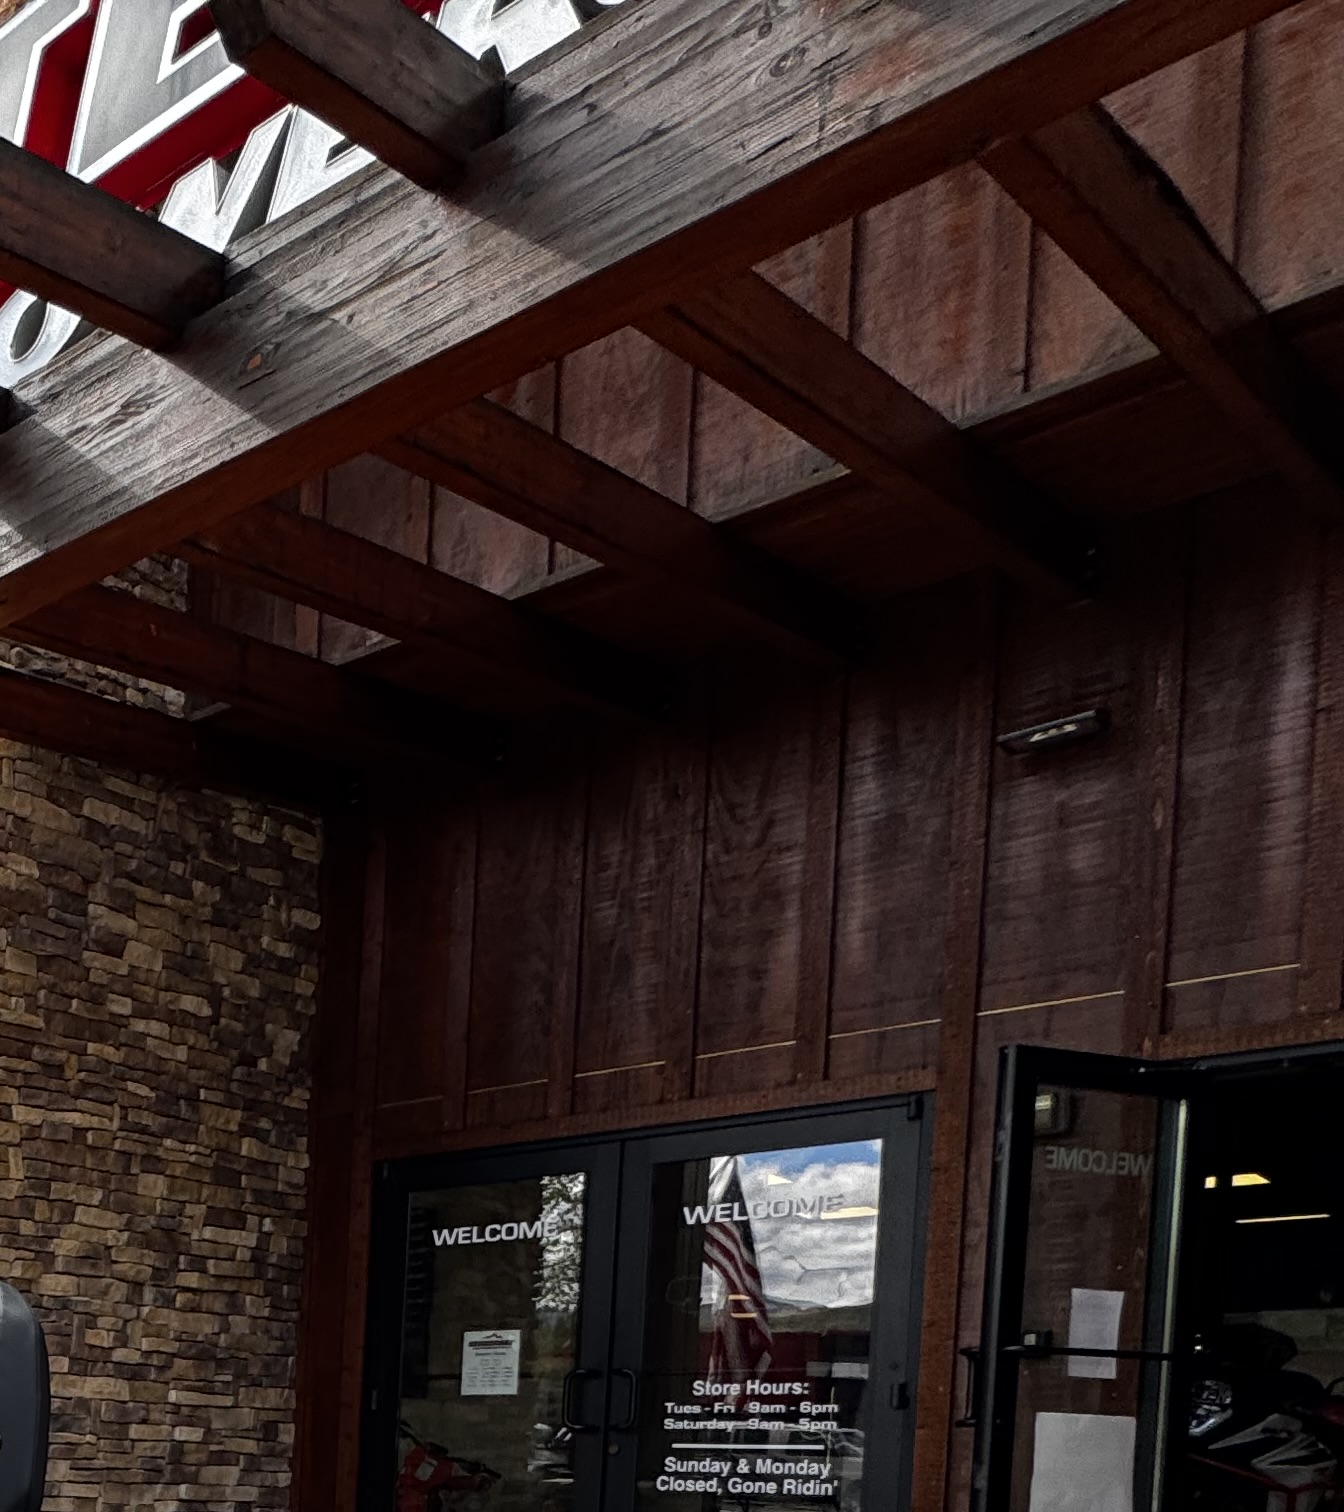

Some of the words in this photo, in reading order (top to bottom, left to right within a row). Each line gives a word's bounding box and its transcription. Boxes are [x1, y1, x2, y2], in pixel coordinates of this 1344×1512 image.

[683, 1193, 846, 1226] WELCOME
[432, 1212, 561, 1246] WELCOME
[692, 1379, 741, 1396] Store
[746, 1379, 810, 1396] Hours:
[664, 1402, 701, 1414] Tues
[713, 1402, 735, 1414] Fri
[748, 1401, 785, 1414] 9am
[799, 1401, 839, 1416] 6pm
[663, 1418, 735, 1432] Saturday
[747, 1418, 784, 1430] 9am
[798, 1417, 837, 1432] 5pm
[664, 1456, 732, 1477] Sunday
[736, 1458, 750, 1474] &
[755, 1458, 832, 1479] Monday
[656, 1475, 723, 1495] Closed,
[727, 1477, 777, 1494] Gone
[782, 1479, 839, 1496] Ridin'
